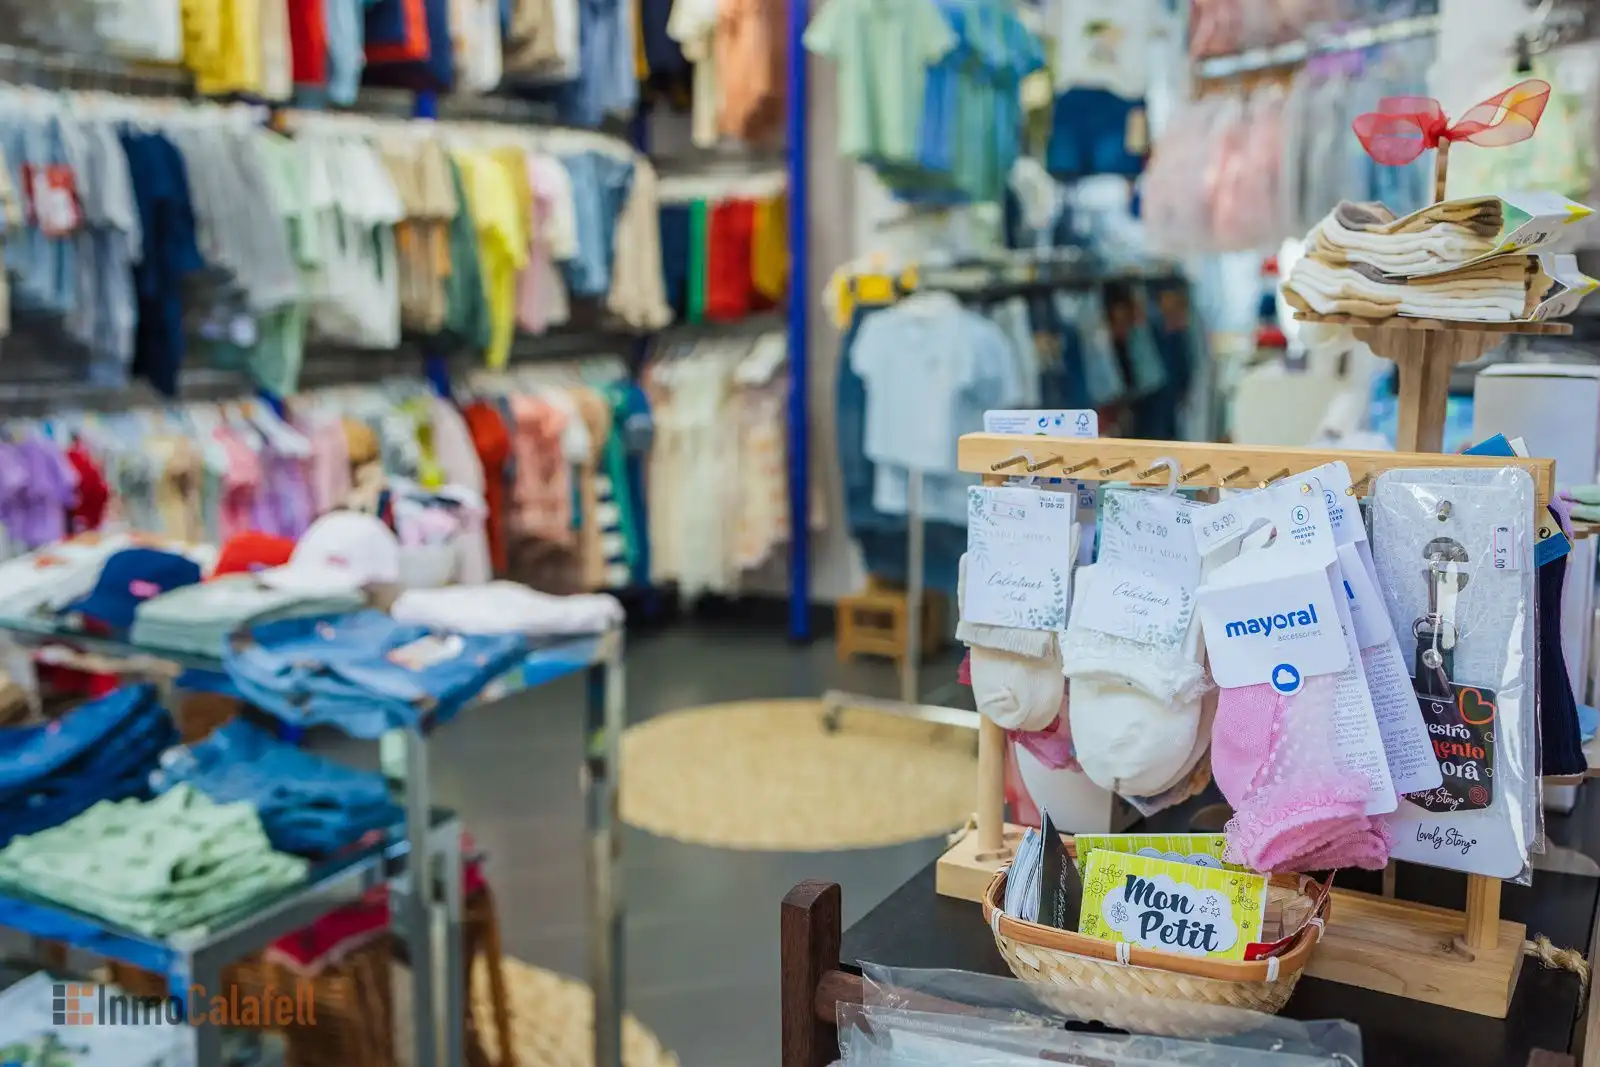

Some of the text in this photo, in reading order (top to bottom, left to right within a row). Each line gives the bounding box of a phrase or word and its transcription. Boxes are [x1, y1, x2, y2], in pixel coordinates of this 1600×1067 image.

[1297, 509, 1304, 520] 6
[1328, 508, 1344, 516] nths
[1291, 525, 1316, 534] months
[1294, 532, 1315, 540] meses
[986, 570, 1044, 590] Calcetines
[1112, 581, 1171, 607] Calcetines
[1225, 603, 1318, 637] mayoral
[1277, 630, 1322, 642] accessories
[1428, 721, 1471, 740] estro
[1433, 740, 1485, 759] ento
[1442, 760, 1481, 782] ora
[1436, 787, 1462, 811] Story
[1416, 823, 1473, 855] Lovely Story
[1124, 874, 1194, 915] Mon
[1138, 910, 1220, 952] Petit
